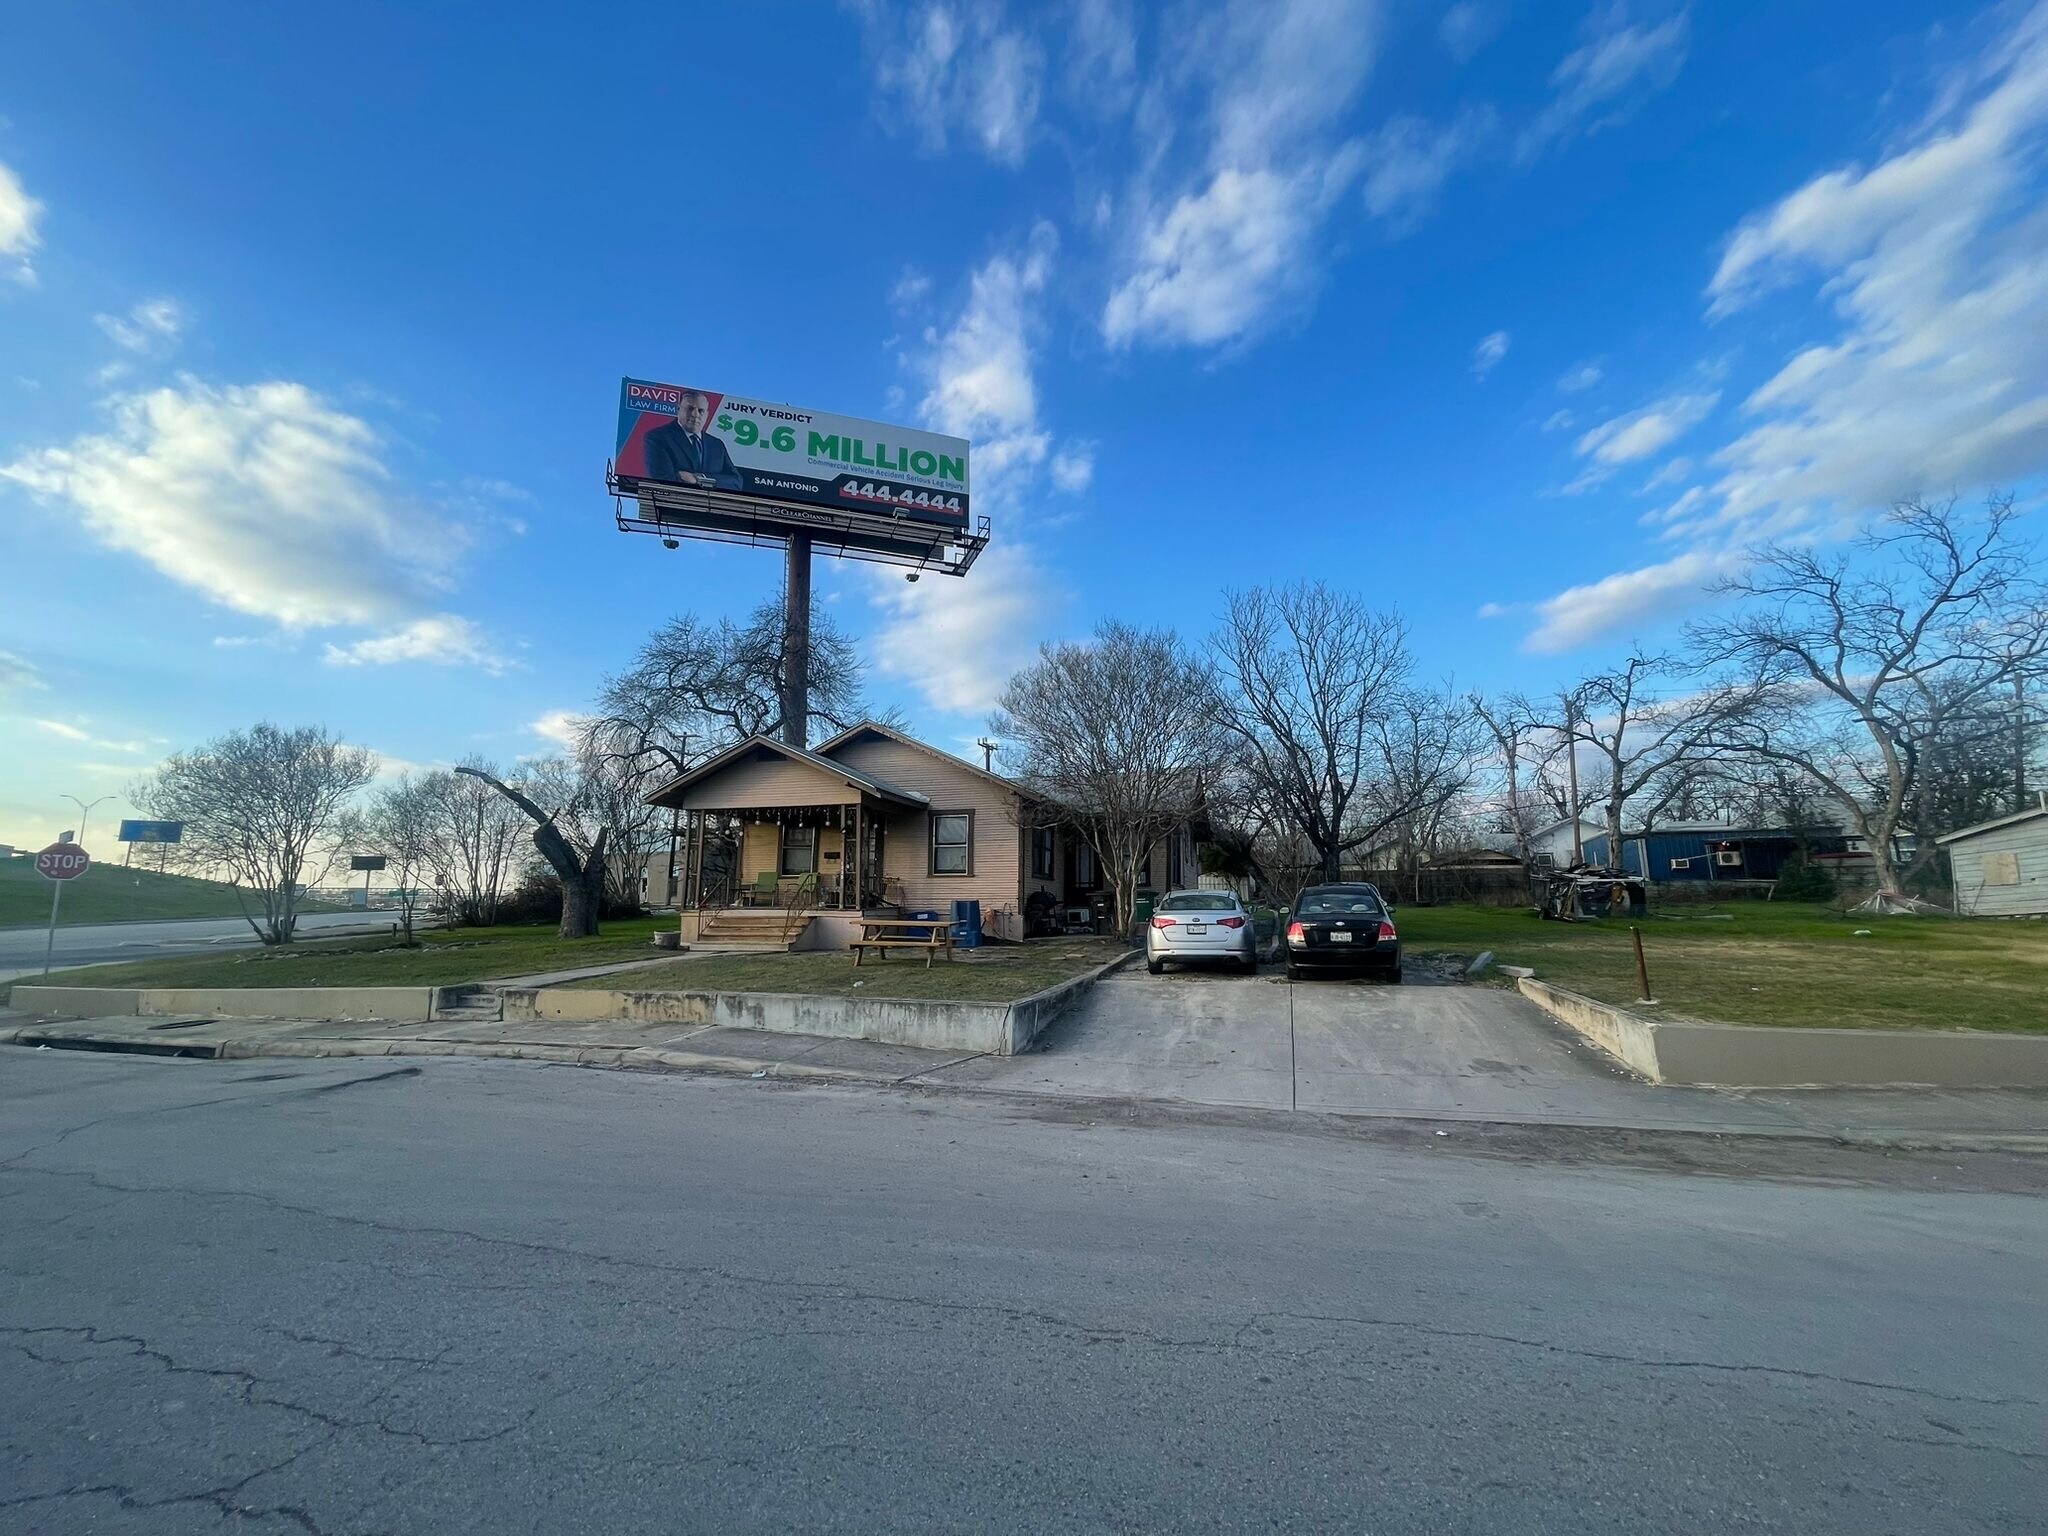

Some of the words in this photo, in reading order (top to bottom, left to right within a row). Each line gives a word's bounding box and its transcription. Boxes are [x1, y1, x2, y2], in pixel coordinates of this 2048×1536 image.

[630, 386, 677, 403] DAVIS
[630, 399, 651, 409] LAW
[654, 403, 676, 413] FIRM
[724, 402, 757, 414] JURY
[759, 407, 813, 424] VERDICT
[717, 413, 796, 453] $9.6
[808, 430, 964, 482] MILLION
[807, 457, 849, 471] Commercial
[850, 464, 875, 474] Vehicle
[875, 469, 905, 480] Accident
[906, 473, 931, 484] Serious
[932, 478, 945, 488] Leg
[754, 476, 774, 486] SAN
[776, 480, 819, 493] ANTONIO
[843, 480, 960, 512] 444.4444
[39, 853, 86, 869] STOP
